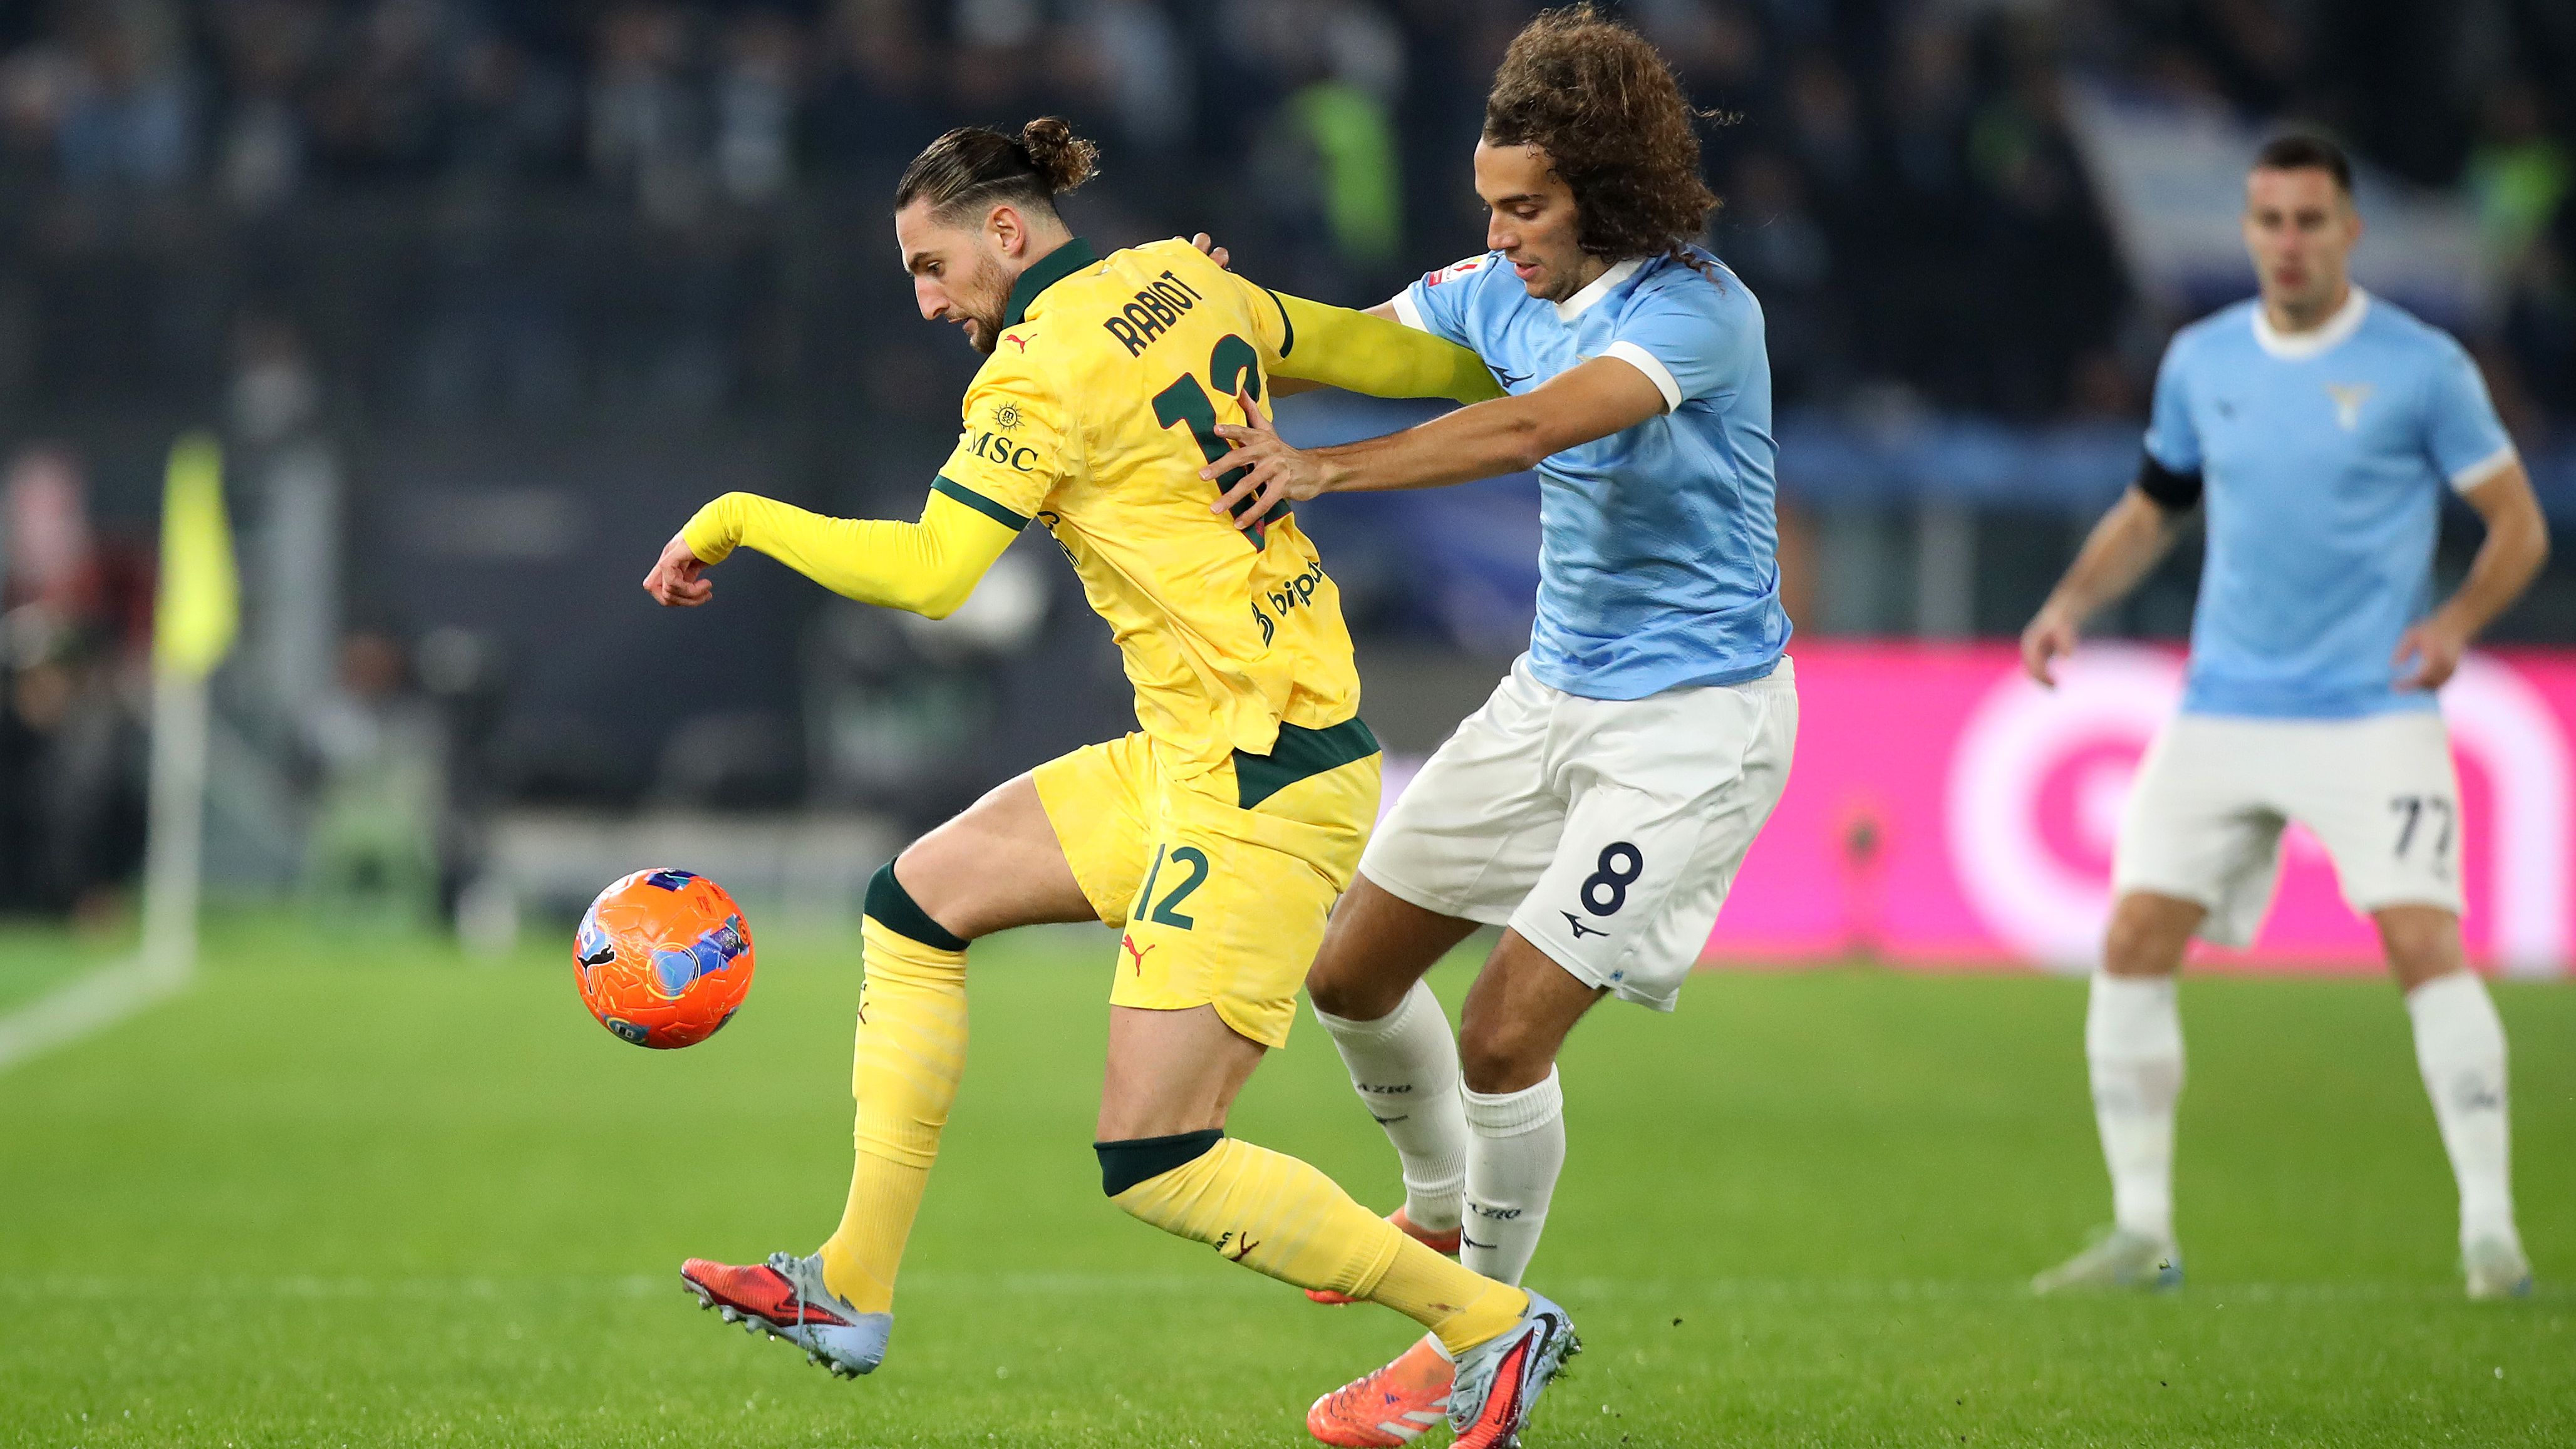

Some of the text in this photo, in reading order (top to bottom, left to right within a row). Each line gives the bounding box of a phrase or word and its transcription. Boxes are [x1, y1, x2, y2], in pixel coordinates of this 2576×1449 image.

[1103, 270, 1203, 358] RABIOT
[966, 427, 1038, 472] MSC
[2387, 793, 2453, 858] 77
[1134, 843, 1208, 931] 12
[1581, 841, 1643, 916] 8
